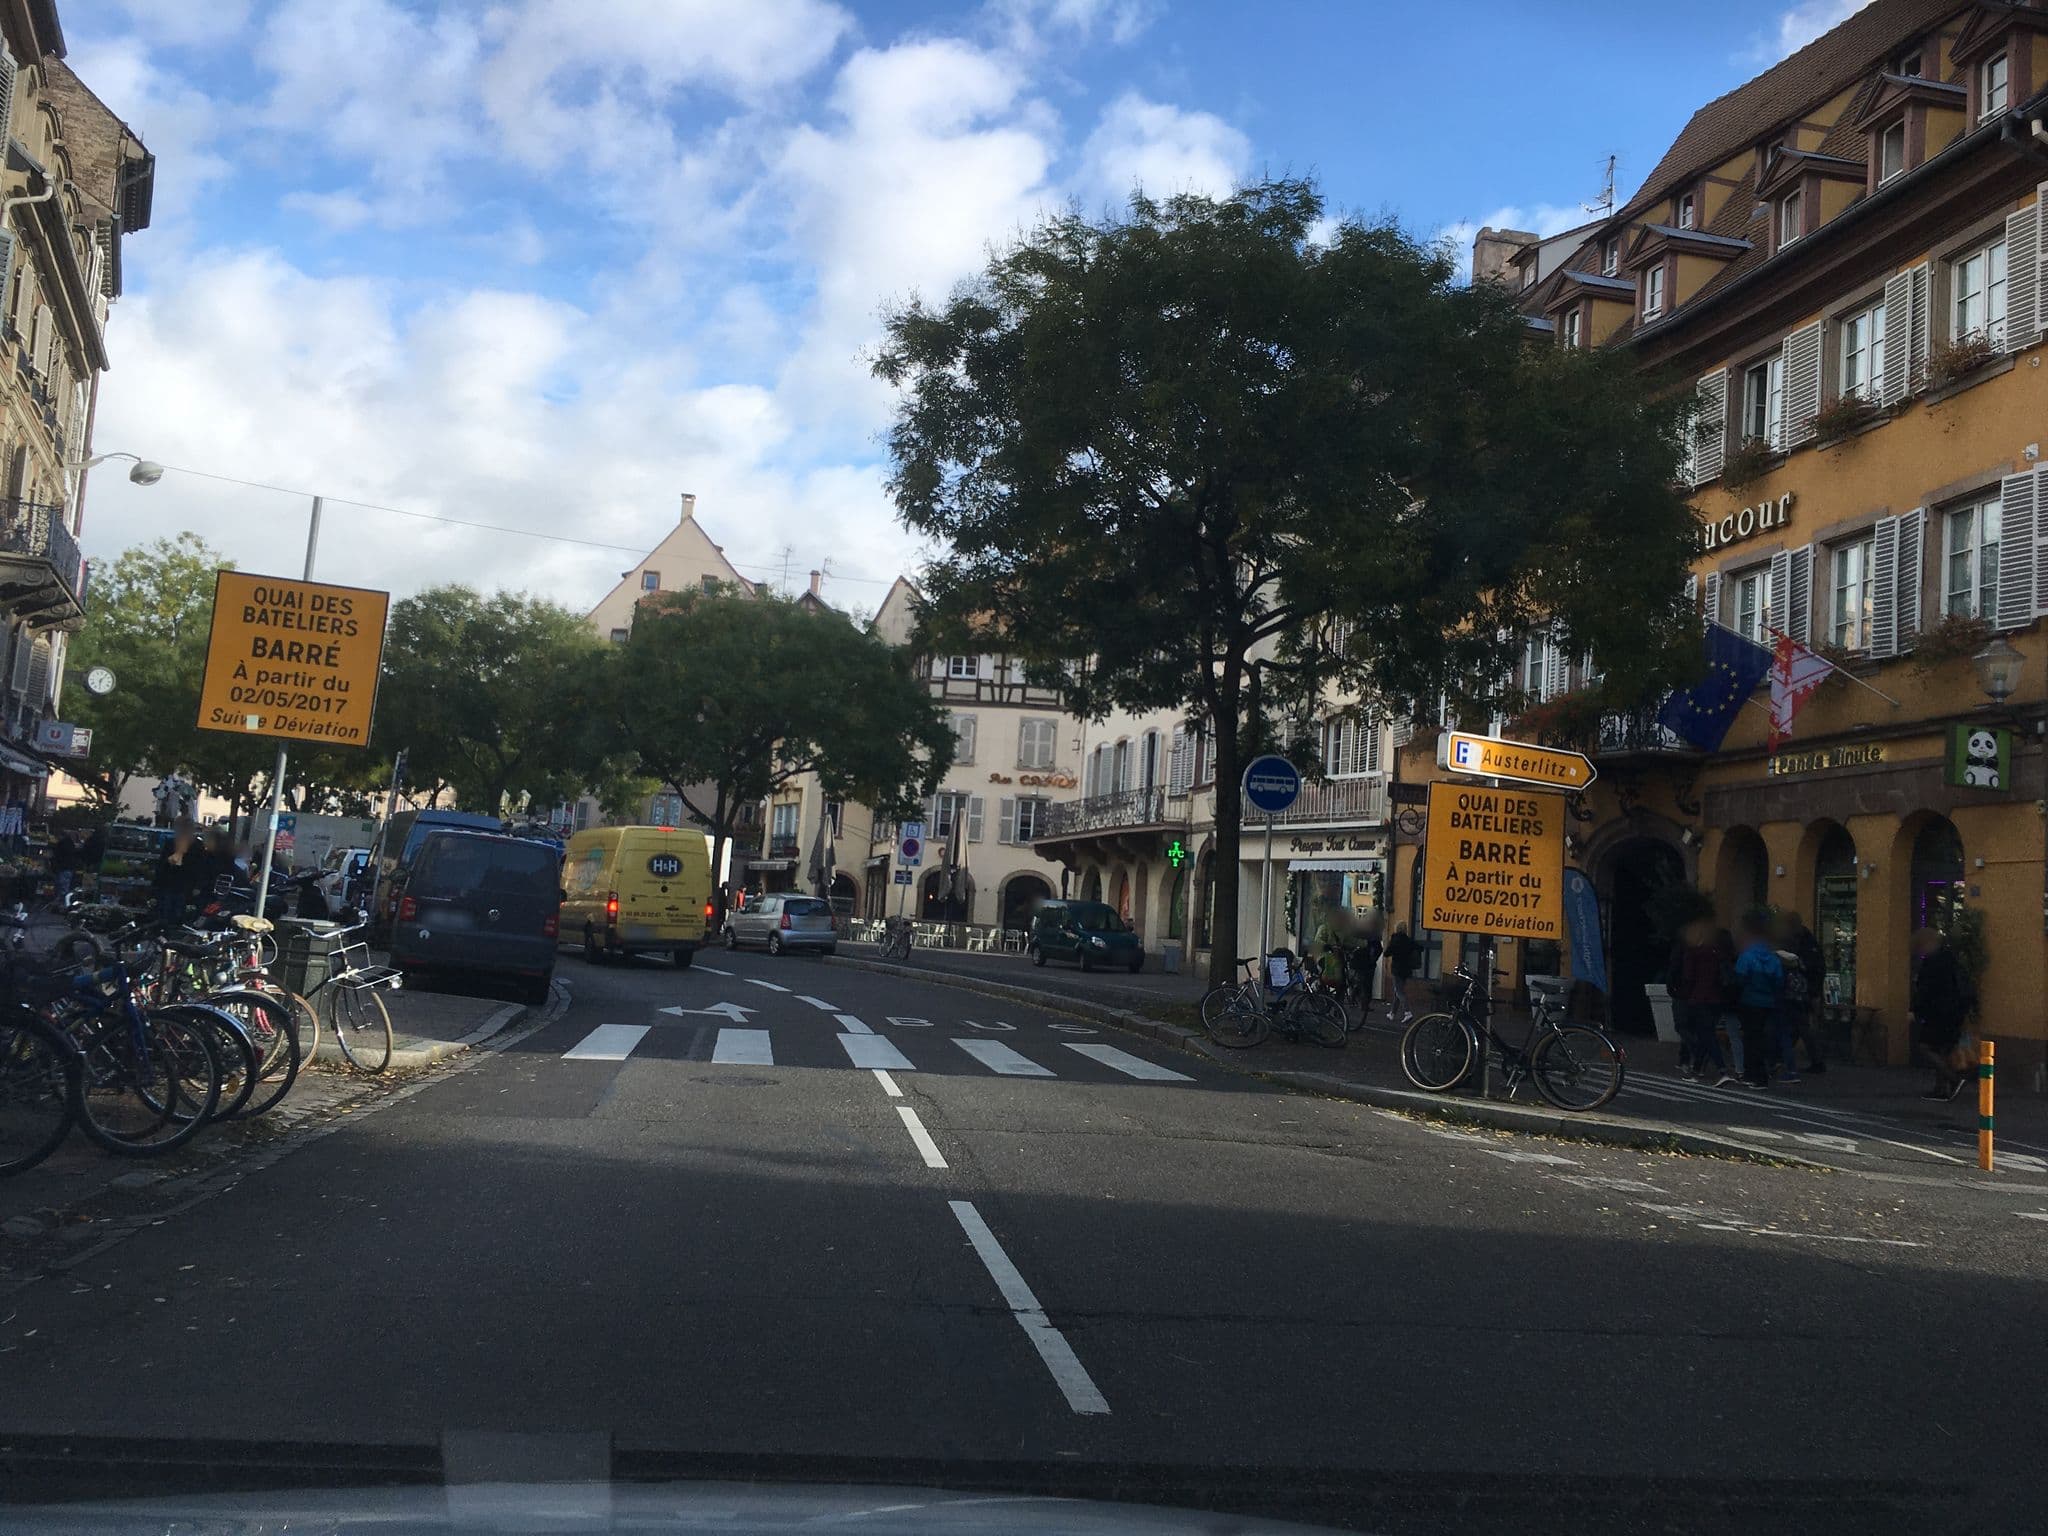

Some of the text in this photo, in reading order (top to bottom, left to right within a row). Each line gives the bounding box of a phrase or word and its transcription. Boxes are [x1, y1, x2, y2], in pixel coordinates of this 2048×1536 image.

[1694, 490, 1791, 550] ucour
[253, 587, 353, 616] QUAI DES
[242, 606, 358, 637] BATELIERS
[252, 637, 341, 667] BARRÉ
[233, 660, 350, 692] À partir du
[230, 686, 347, 713] 02/05/2017
[210, 707, 359, 739] Suive Déviation
[1481, 748, 1567, 779] Austerlitz
[1458, 793, 1539, 817] QUAI DES
[1451, 812, 1544, 836] BATELIERS
[1459, 840, 1531, 865] BARRÉ
[1446, 862, 1541, 888] À partir du
[1445, 886, 1541, 909] 02/05/2017
[1432, 907, 1555, 932] Suivre Déviation
[886, 1016, 1099, 1034] BUS
